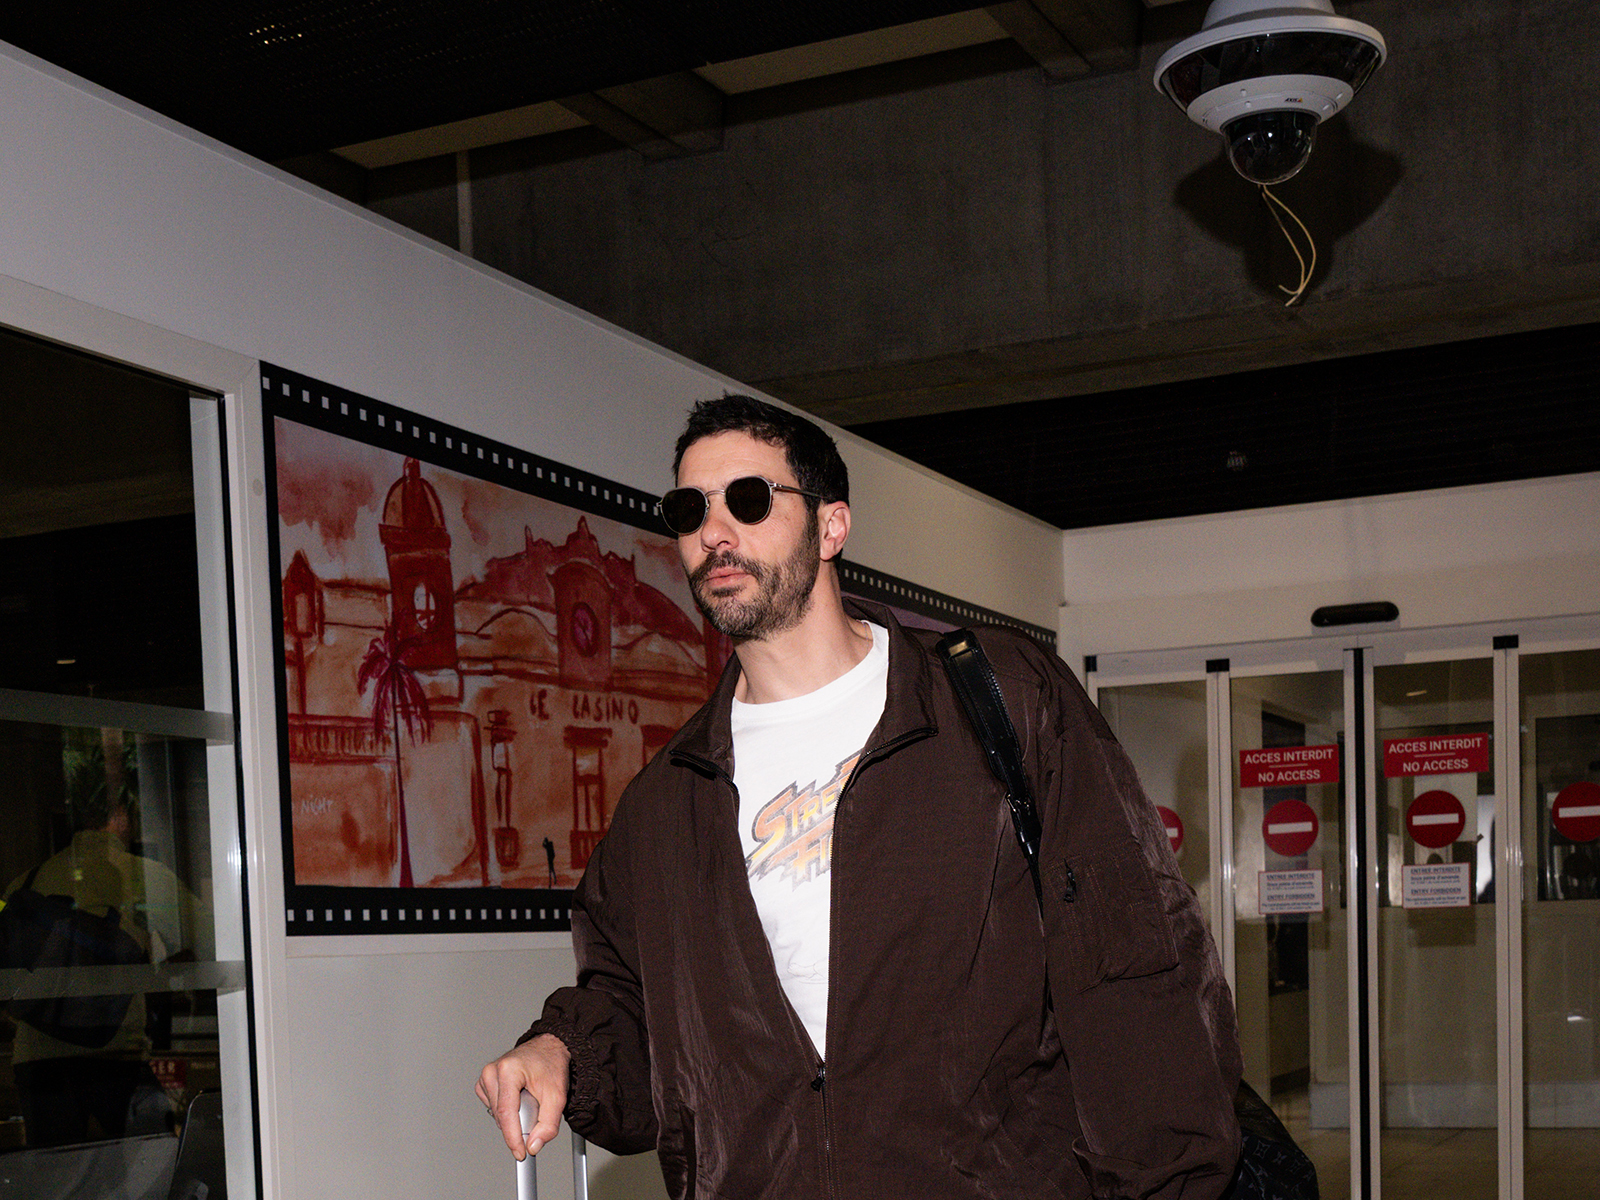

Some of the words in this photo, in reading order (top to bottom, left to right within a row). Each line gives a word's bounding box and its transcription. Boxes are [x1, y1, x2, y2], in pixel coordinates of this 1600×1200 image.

[1388, 741, 1427, 754] ACCES
[1429, 737, 1482, 751] INTERDIT
[1244, 752, 1280, 764] ACCES
[1283, 748, 1334, 761] INTERDIT
[1402, 761, 1420, 773] NO
[1423, 758, 1469, 771] ACCESS
[1258, 771, 1275, 783] NO
[1277, 769, 1320, 782] ACCESS
